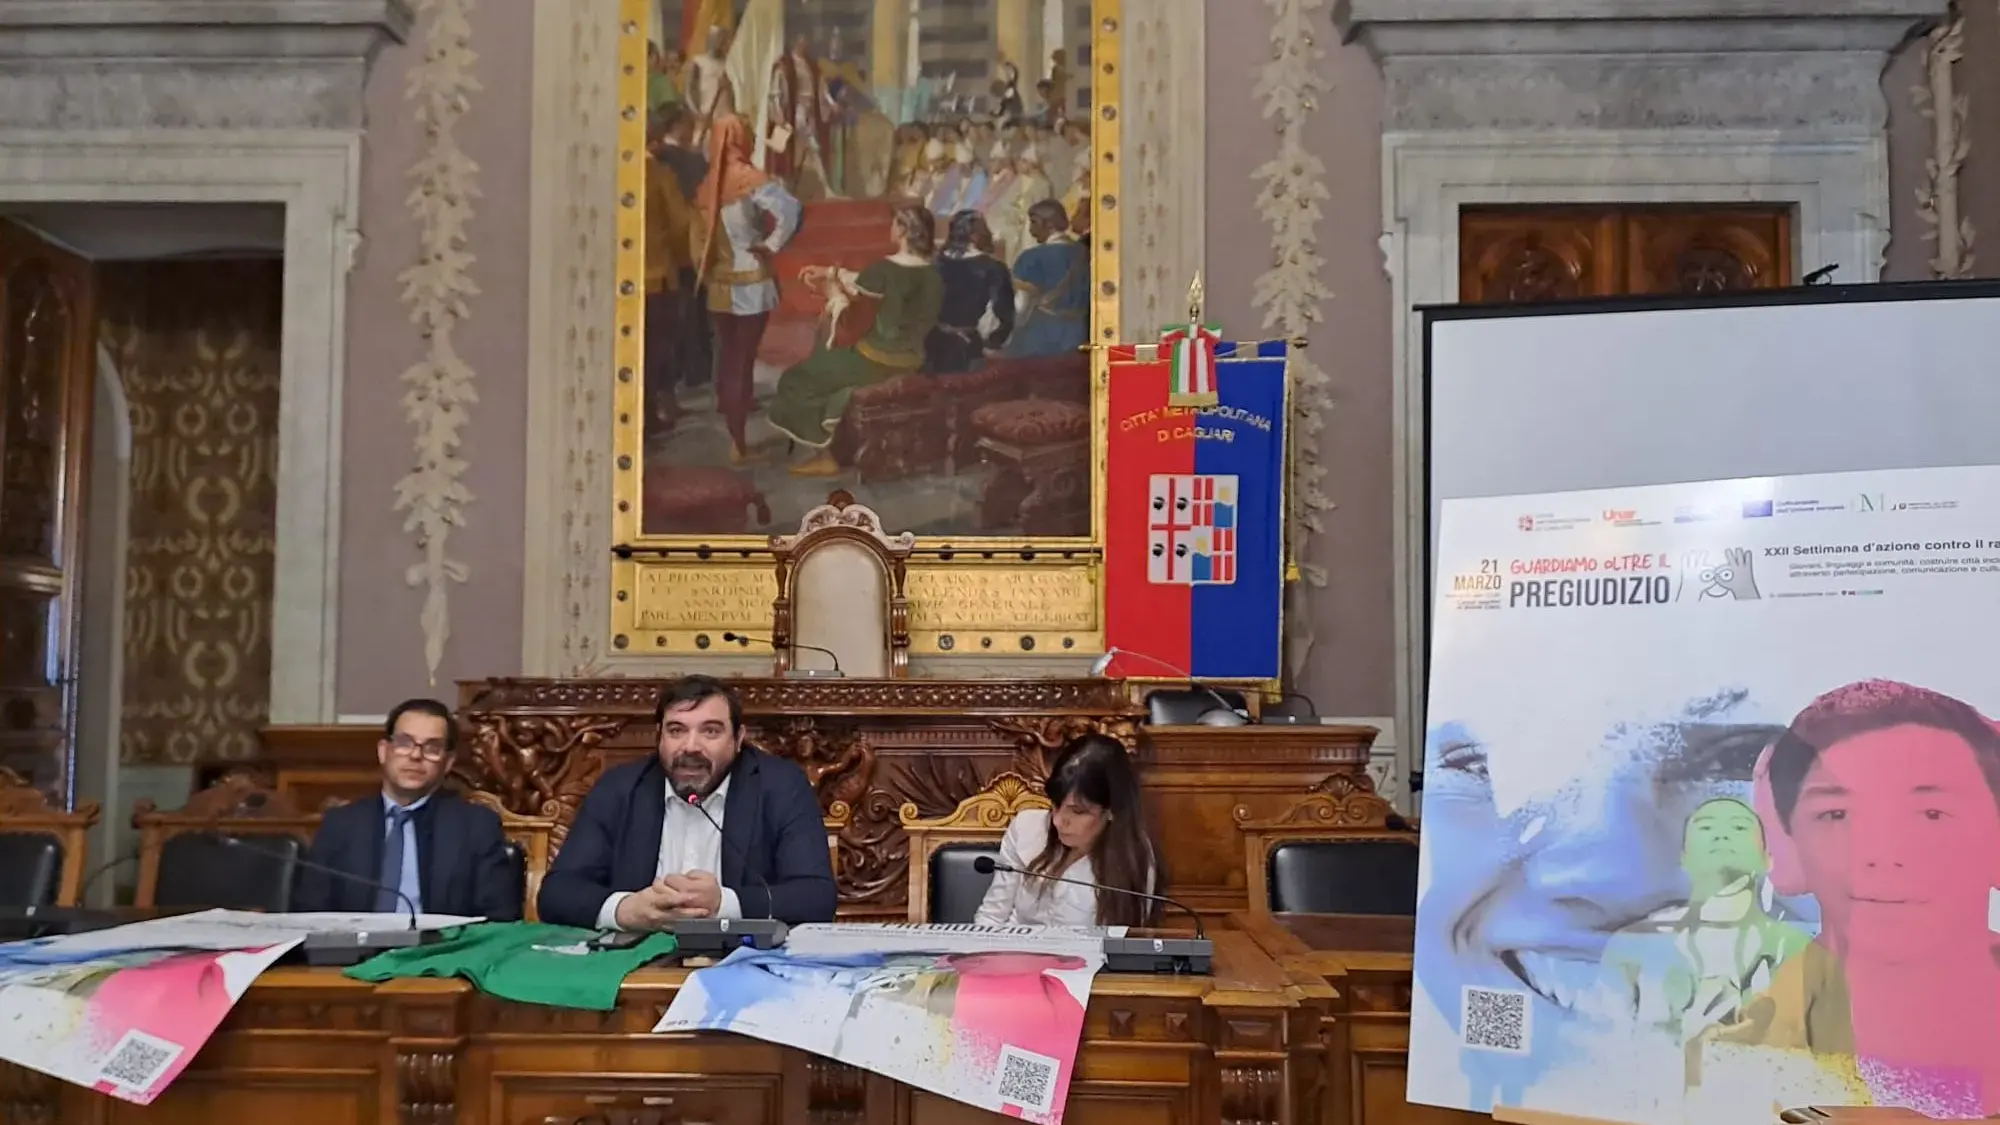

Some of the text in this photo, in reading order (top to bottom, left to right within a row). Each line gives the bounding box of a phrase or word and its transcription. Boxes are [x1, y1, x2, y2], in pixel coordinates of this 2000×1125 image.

[1173, 426, 1236, 443] CAGLIARI
[1764, 547, 1789, 557] XXII
[1793, 544, 1859, 556] Settimana
[1863, 541, 1920, 553] d'azione
[1925, 539, 1971, 550] contro
[1976, 539, 1983, 549] il
[1481, 558, 1498, 574] 21
[1510, 557, 1597, 575] GUARDIAMO
[1658, 553, 1671, 568] IL
[1961, 555, 1980, 565] città
[1901, 564, 1969, 574] comunicazione
[1454, 575, 1501, 590] MARZO
[1510, 575, 1671, 608] PREGIUDIZIO
